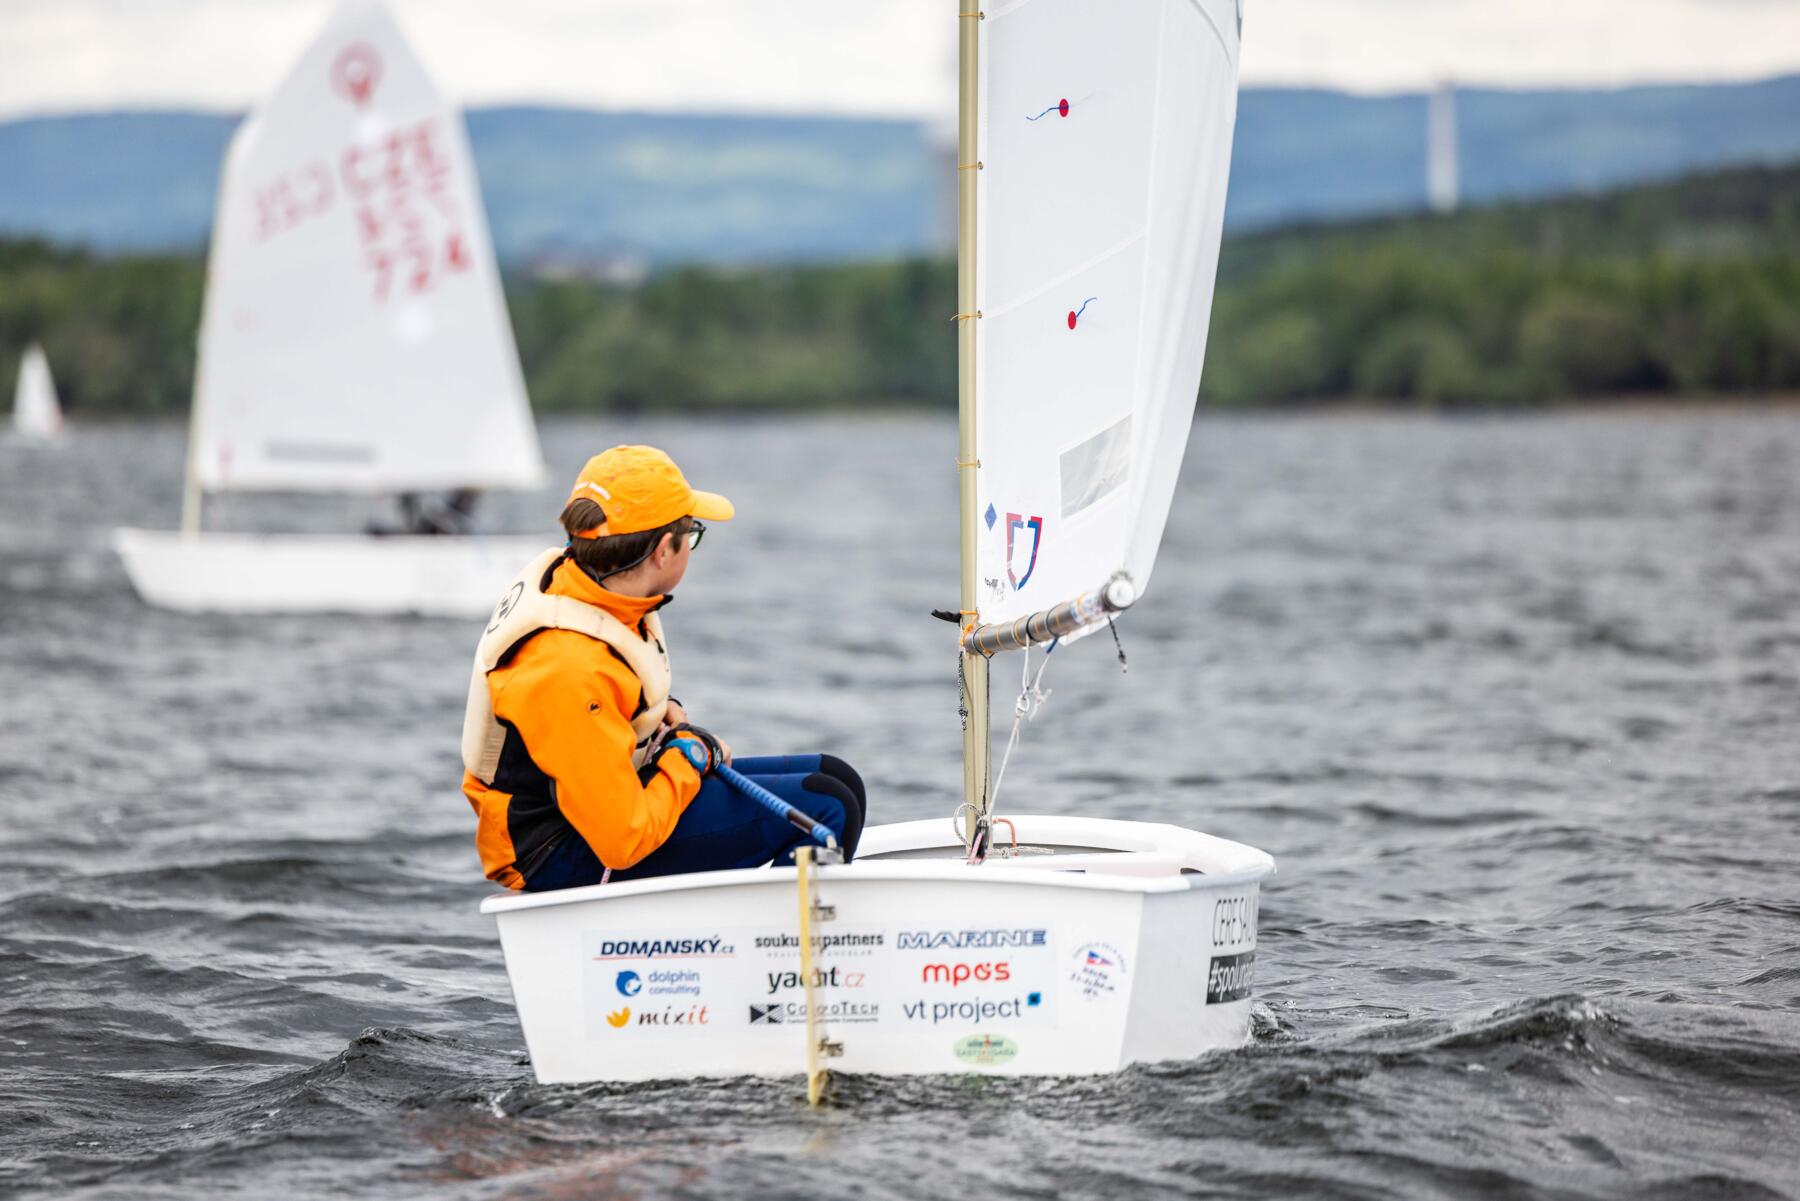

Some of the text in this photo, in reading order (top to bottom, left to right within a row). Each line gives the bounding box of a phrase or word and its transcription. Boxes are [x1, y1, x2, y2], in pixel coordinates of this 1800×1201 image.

[897, 930, 1047, 949] MARINE
[648, 970, 700, 984] dolphin
[649, 985, 700, 996] consulting
[638, 1005, 710, 1025] mixit
[903, 997, 1021, 1024] vt project
